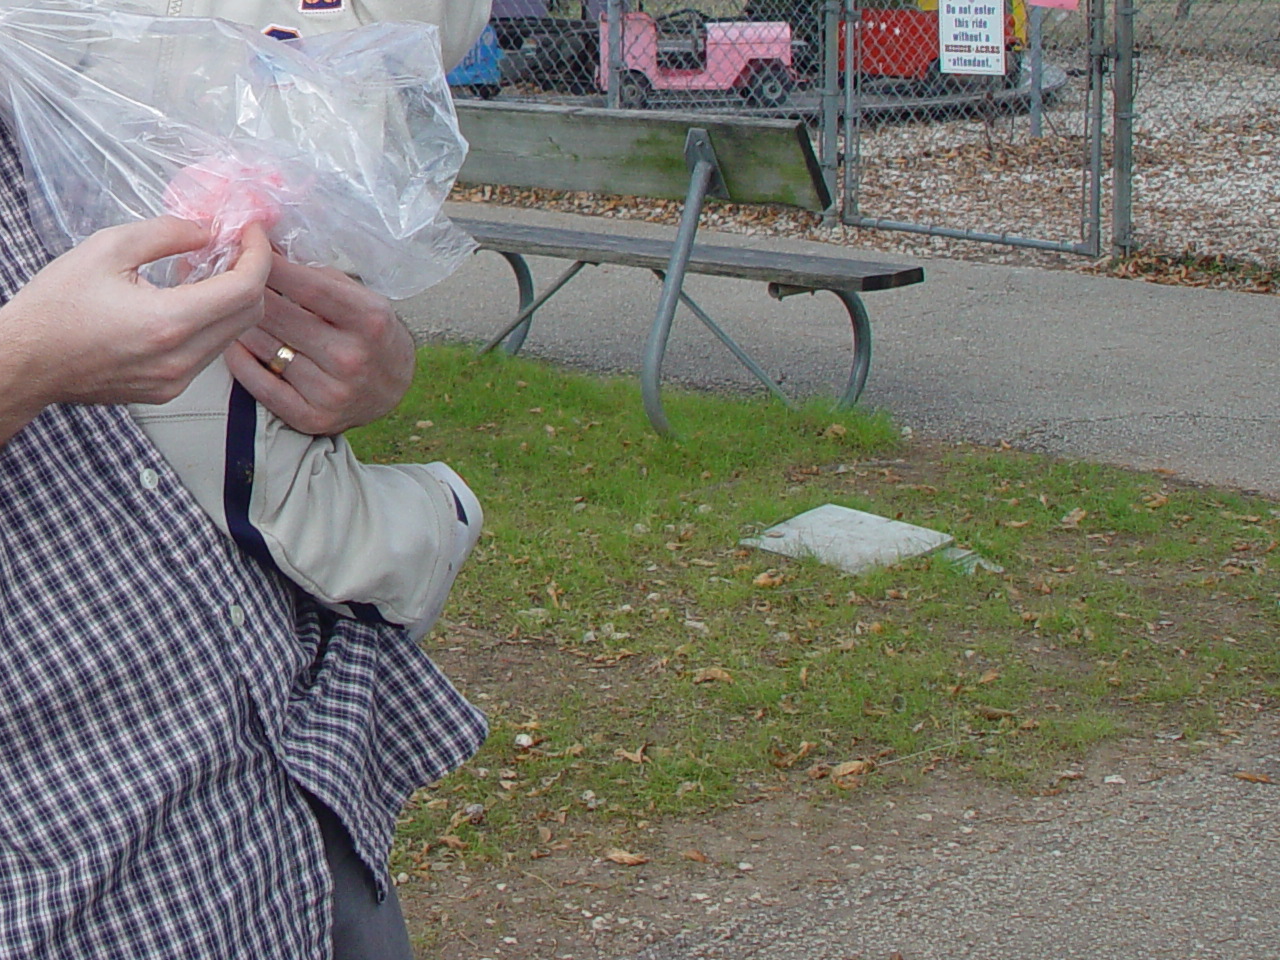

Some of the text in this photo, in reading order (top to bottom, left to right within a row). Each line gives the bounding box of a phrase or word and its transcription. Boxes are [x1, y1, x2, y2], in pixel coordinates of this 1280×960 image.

[946, 4, 995, 15] Do not enter
[954, 18, 987, 28] this ride
[953, 31, 990, 42] without a
[952, 57, 992, 68] attendant.
